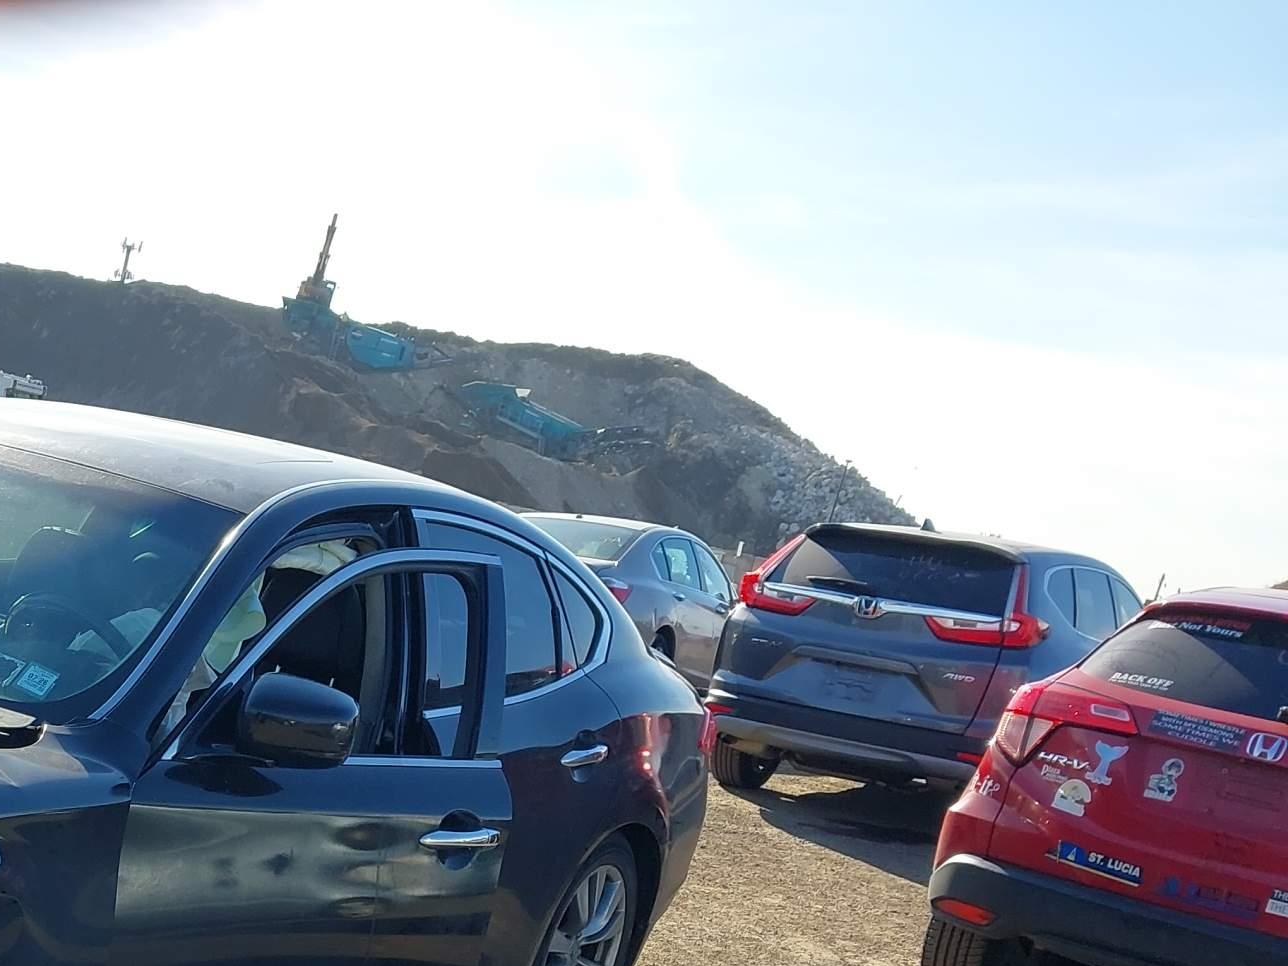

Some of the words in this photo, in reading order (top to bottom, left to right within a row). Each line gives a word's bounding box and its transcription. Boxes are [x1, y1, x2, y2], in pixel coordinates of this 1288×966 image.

[1204, 624, 1244, 638] Yours
[942, 671, 975, 683] AWD
[1110, 671, 1148, 683] BACK
[1147, 677, 1174, 687] OFF
[1222, 737, 1241, 747] WE
[1038, 751, 1090, 769] HR-V
[1087, 852, 1105, 866] ST.
[1106, 858, 1141, 878] LUCIA
